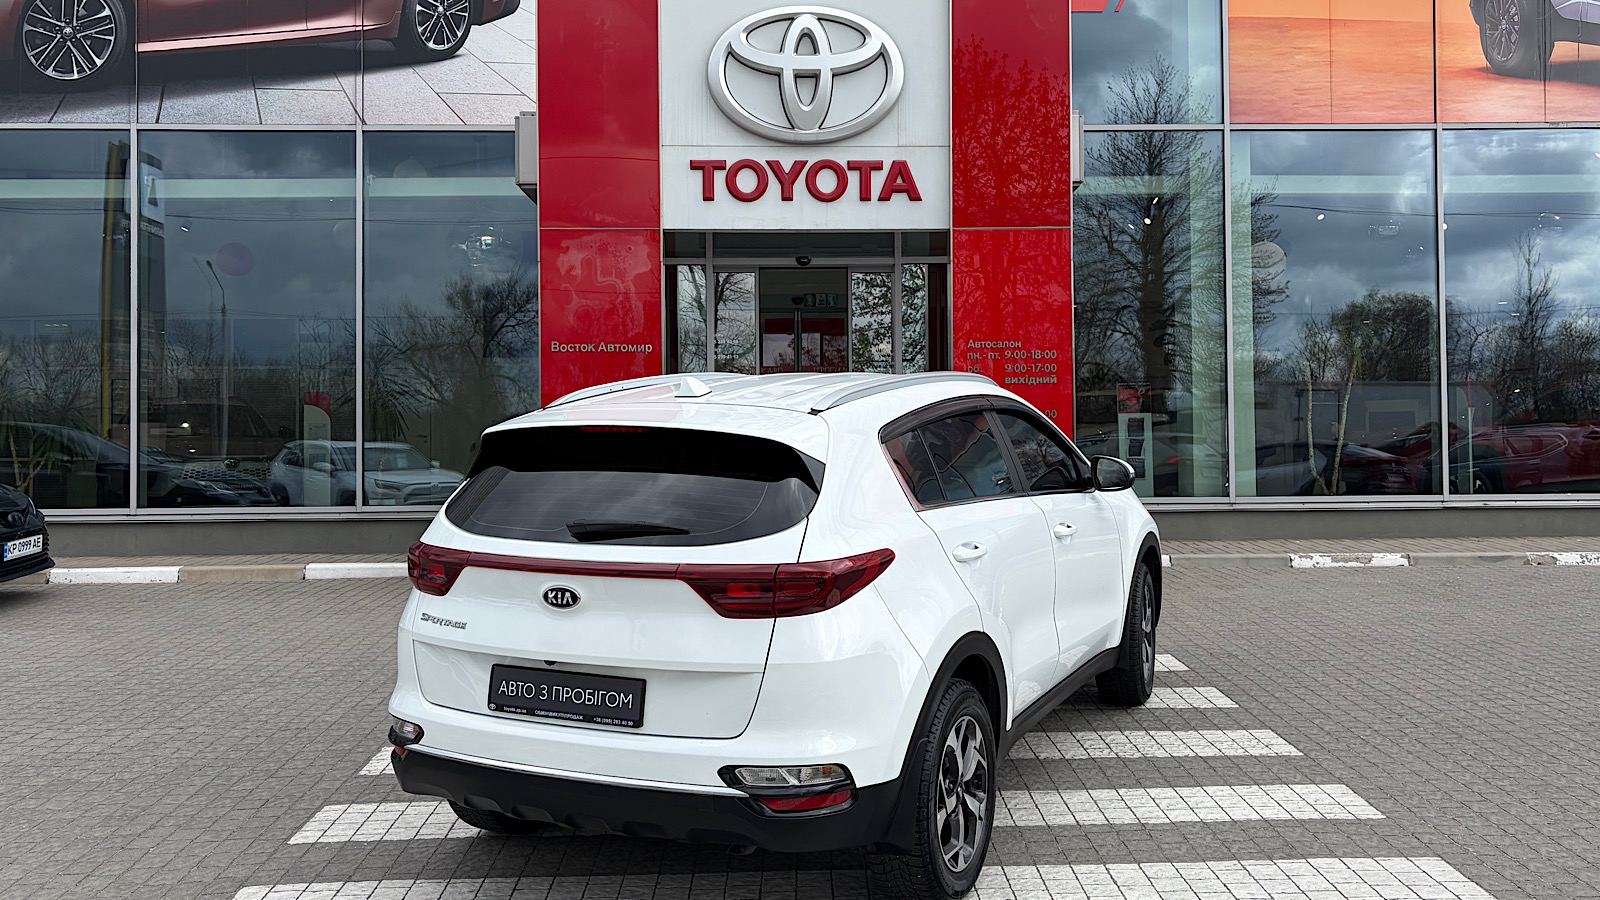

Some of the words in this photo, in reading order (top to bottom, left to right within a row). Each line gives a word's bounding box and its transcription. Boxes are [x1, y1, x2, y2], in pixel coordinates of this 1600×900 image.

[690, 158, 923, 202] TOYOTA
[551, 341, 595, 352] Восток
[598, 341, 653, 355] Автомир
[967, 339, 1022, 348] Автосалон
[1004, 375, 1058, 385] вихідний
[32, 537, 41, 549] AE
[547, 590, 574, 605] KIA
[498, 680, 536, 699] АВТО
[552, 685, 633, 709] ПРОБІГОМ
